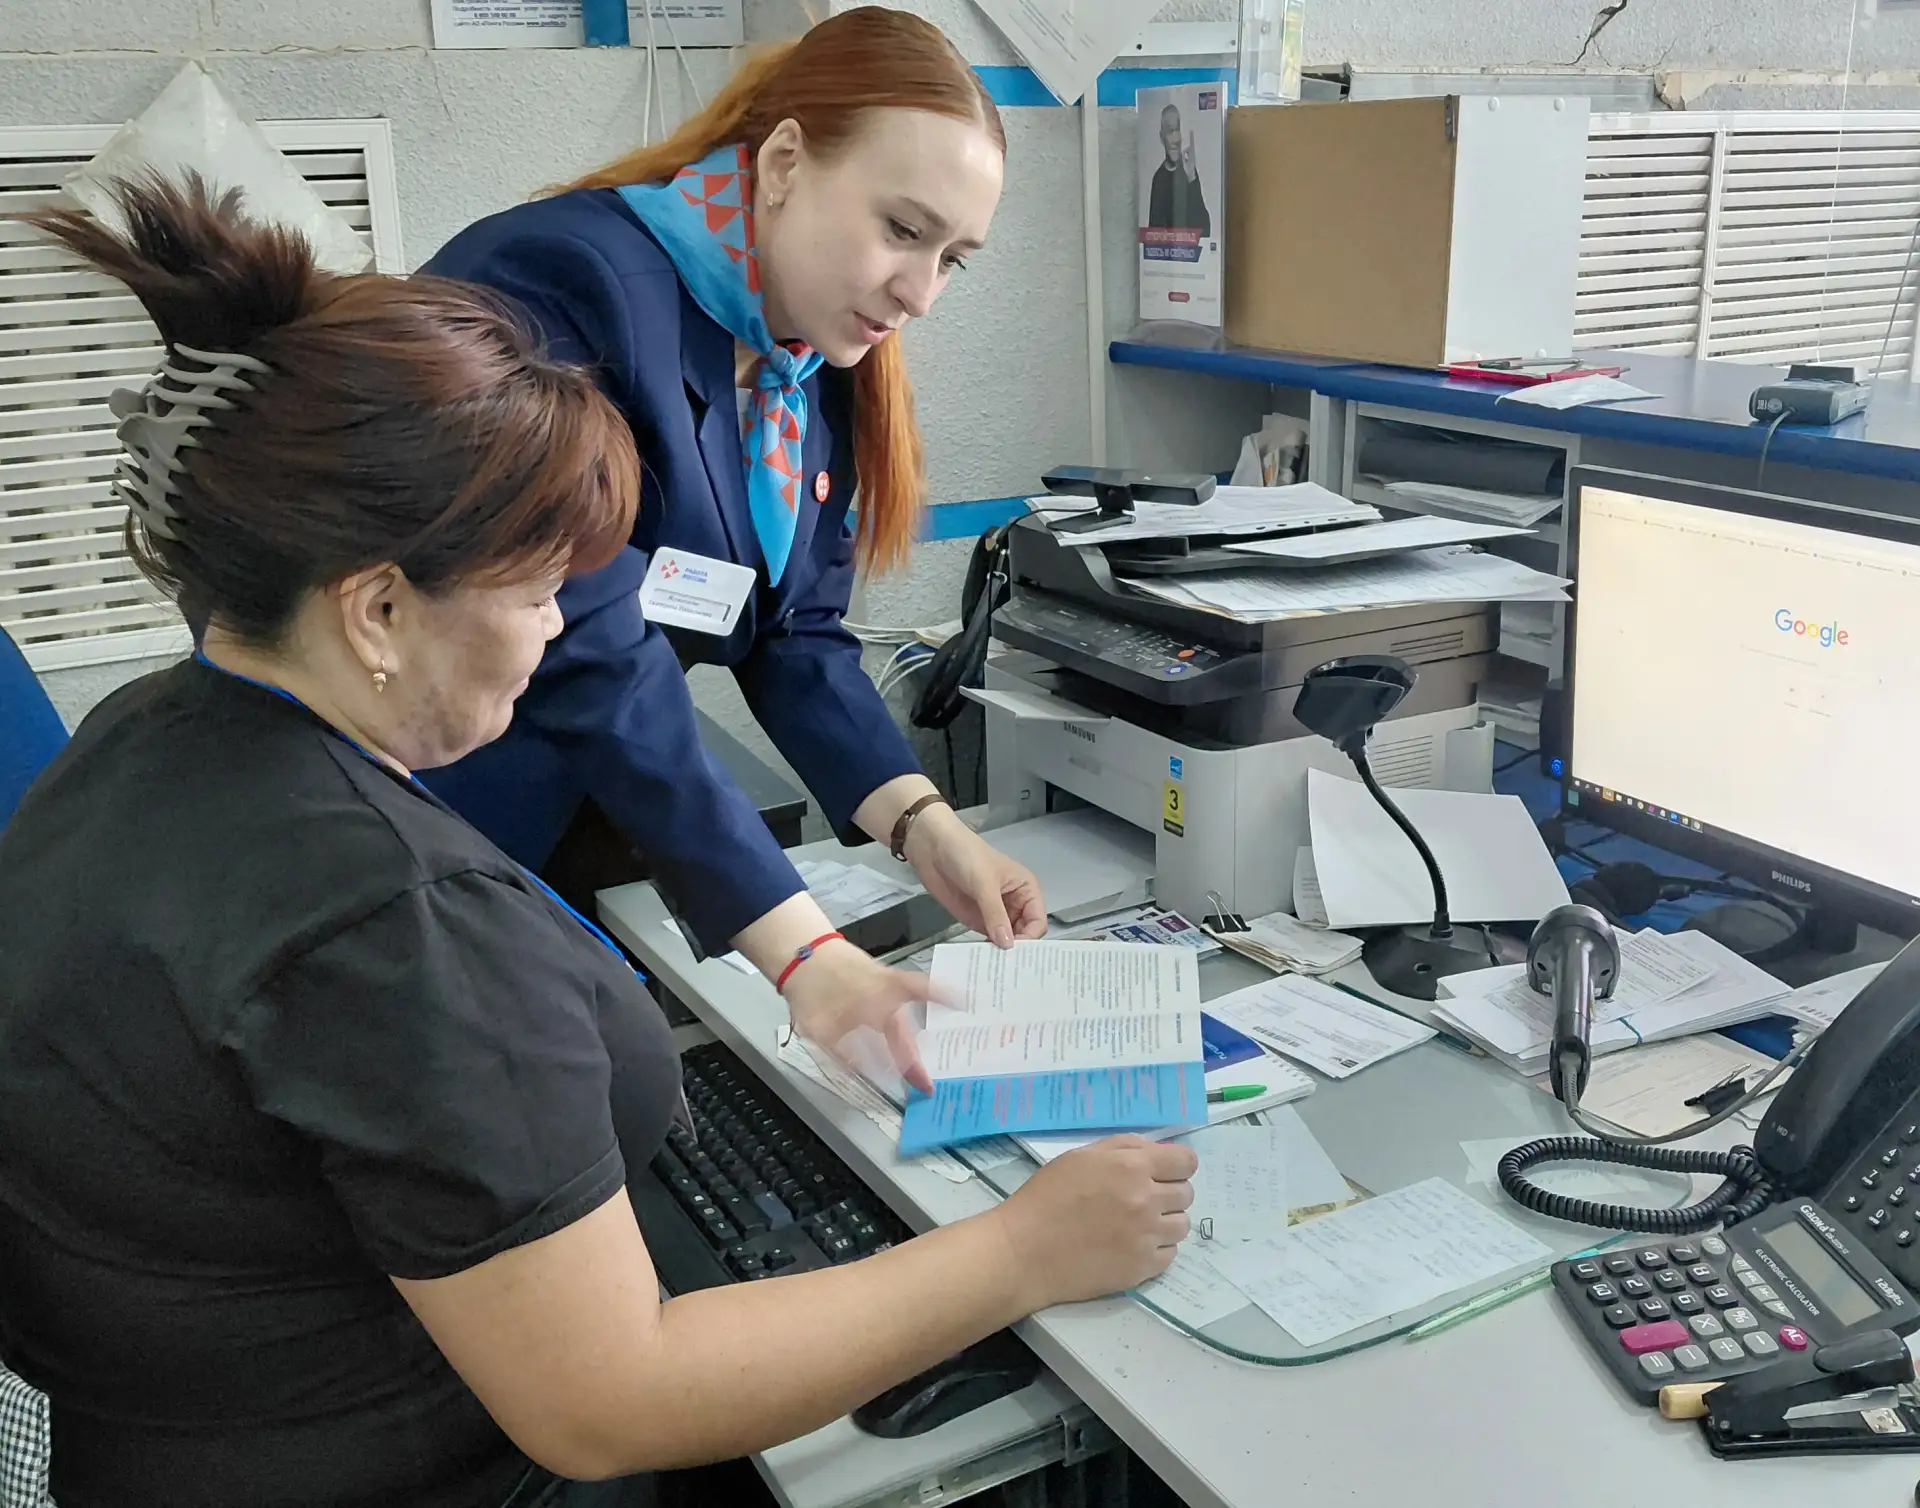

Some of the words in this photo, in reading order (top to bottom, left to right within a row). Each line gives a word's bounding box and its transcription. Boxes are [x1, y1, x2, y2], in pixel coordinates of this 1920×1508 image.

[1774, 608, 1849, 647] Google
[1063, 721, 1095, 743] SAMSUNG
[1169, 789, 1179, 811] 3
[1771, 870, 1811, 893] PHILIPS
[1777, 1125, 1788, 1136] HD
[1908, 1125, 1916, 1134] 1
[1889, 1148, 1897, 1157] 4
[1869, 1169, 1879, 1178] 7
[1895, 1186, 1904, 1195] 8
[1875, 1209, 1885, 1218] 0
[1675, 1245, 1693, 1254] 7
[1644, 1251, 1660, 1260] 4
[1693, 1266, 1710, 1276] 8
[1626, 1279, 1644, 1288] 2
[1755, 1248, 1788, 1281] ELECTRONIC
[1784, 1280, 1821, 1316] CALCULATOR
[1711, 1287, 1728, 1297] 9
[1678, 1294, 1696, 1304] 6
[1783, 1328, 1804, 1341] AC
